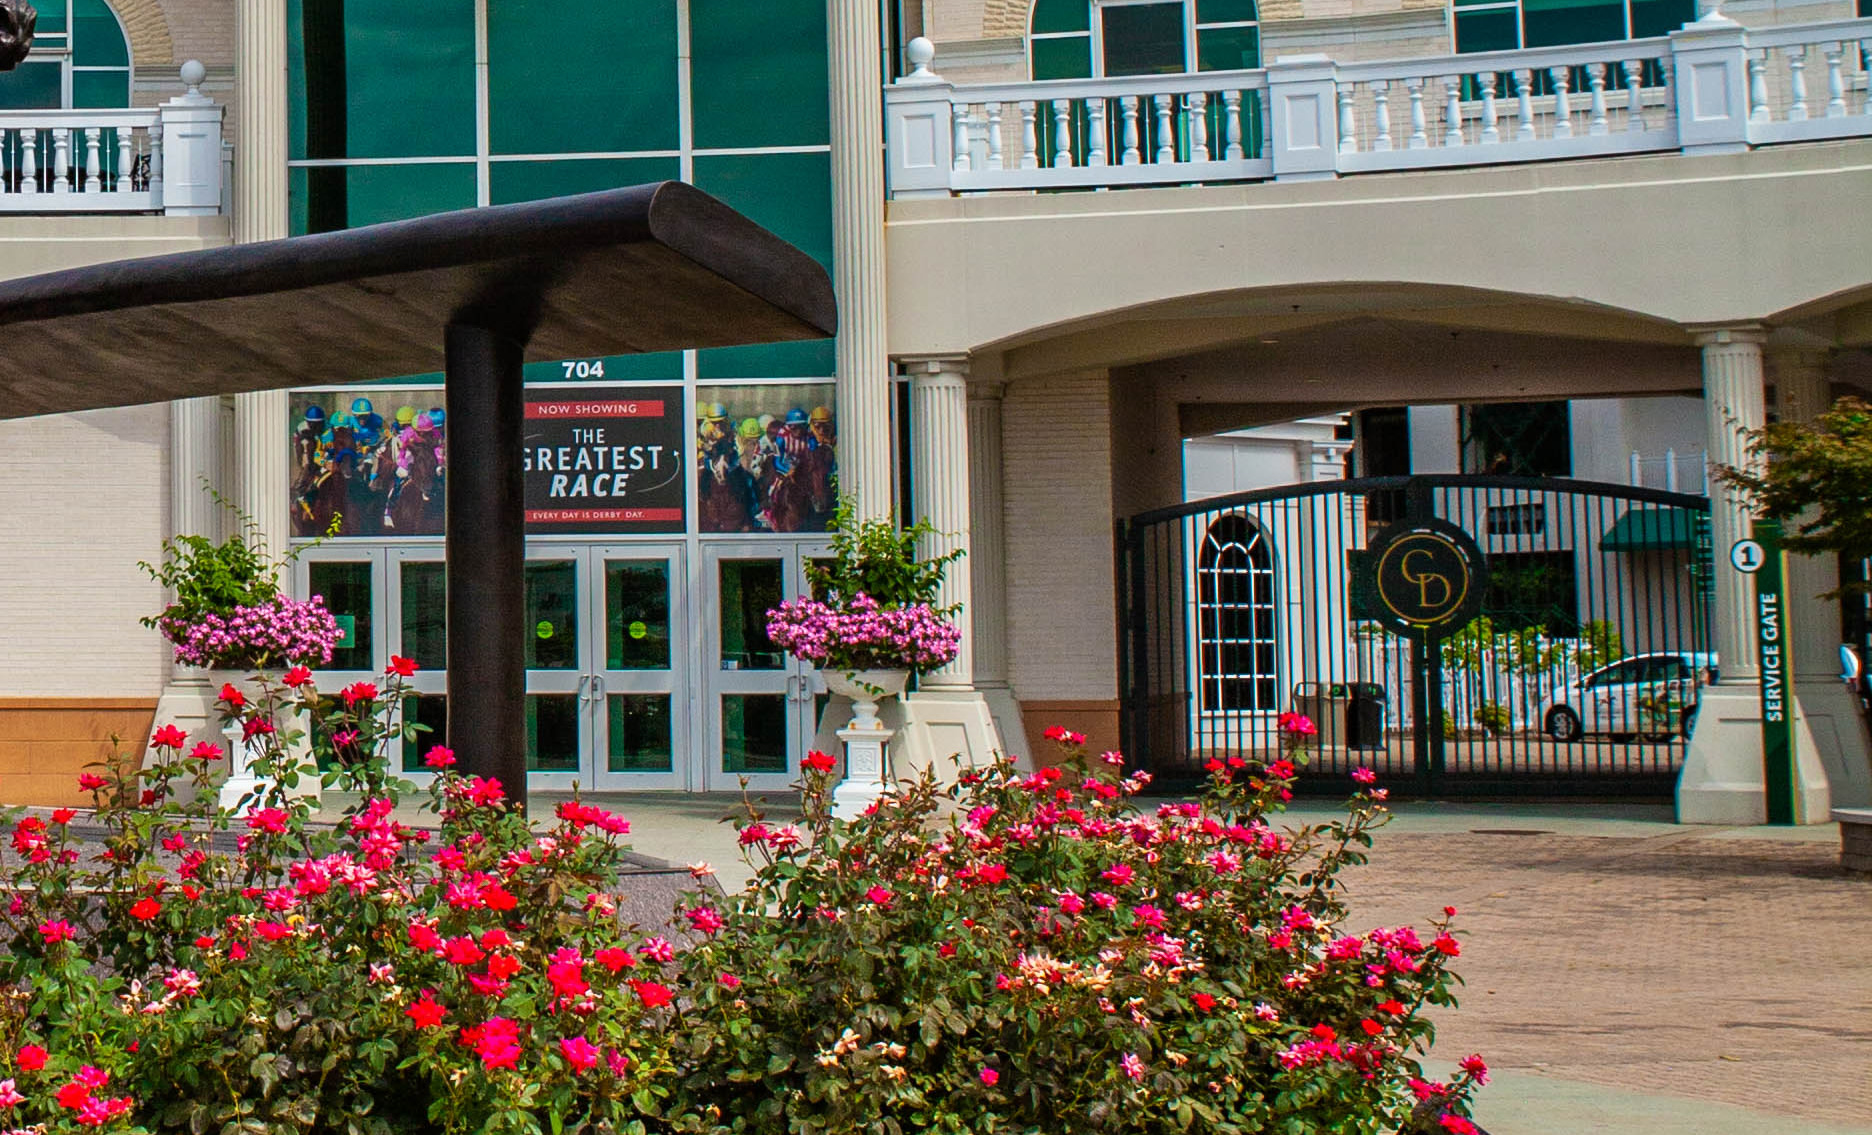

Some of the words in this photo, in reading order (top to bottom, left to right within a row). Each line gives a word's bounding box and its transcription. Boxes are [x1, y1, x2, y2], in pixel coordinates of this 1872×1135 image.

[561, 360, 604, 379] 704
[538, 405, 570, 415] NOW
[575, 403, 637, 415] SHOWING
[572, 428, 606, 444] THE
[549, 473, 630, 498] RACE
[532, 511, 558, 520] EVERY
[561, 511, 578, 520] DAY
[581, 511, 591, 519] IS
[593, 510, 621, 520] DERBY
[625, 510, 646, 519] DAY.
[1740, 546, 1758, 566] 1
[1759, 593, 1780, 641] GATE
[1762, 644, 1783, 722] SERVICE
